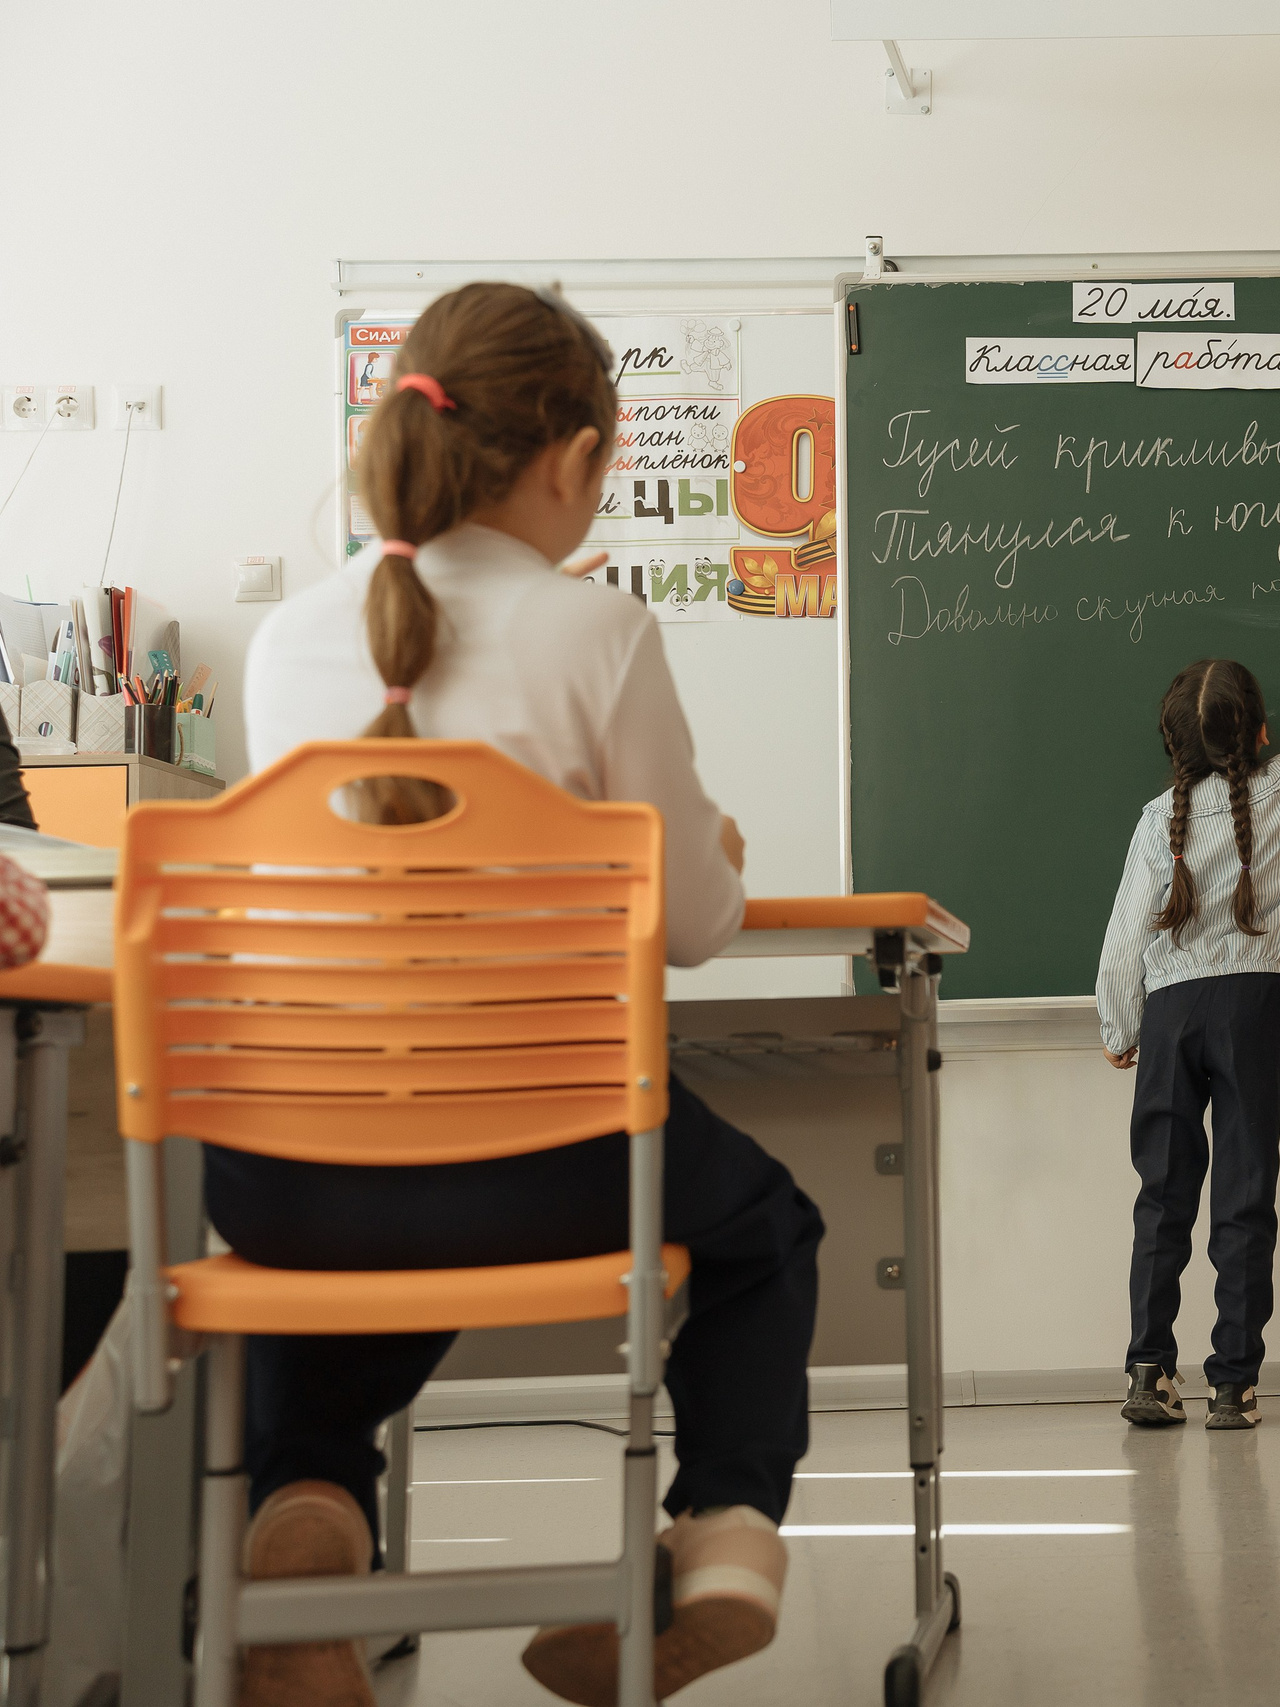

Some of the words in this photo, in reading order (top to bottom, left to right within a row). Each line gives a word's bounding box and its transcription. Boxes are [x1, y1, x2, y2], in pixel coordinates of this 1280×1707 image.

[1077, 287, 1128, 317] 20
[355, 328, 401, 342] Сиди
[614, 346, 674, 388] рк
[968, 344, 1132, 374] Классная
[614, 405, 721, 422] ыпочки
[614, 430, 685, 447] ыган
[883, 409, 1021, 498] Гусей
[871, 509, 1131, 588] Тянулся
[1167, 506, 1194, 538] к
[887, 575, 1059, 646] Довольно
[1076, 584, 1226, 644] скучная
